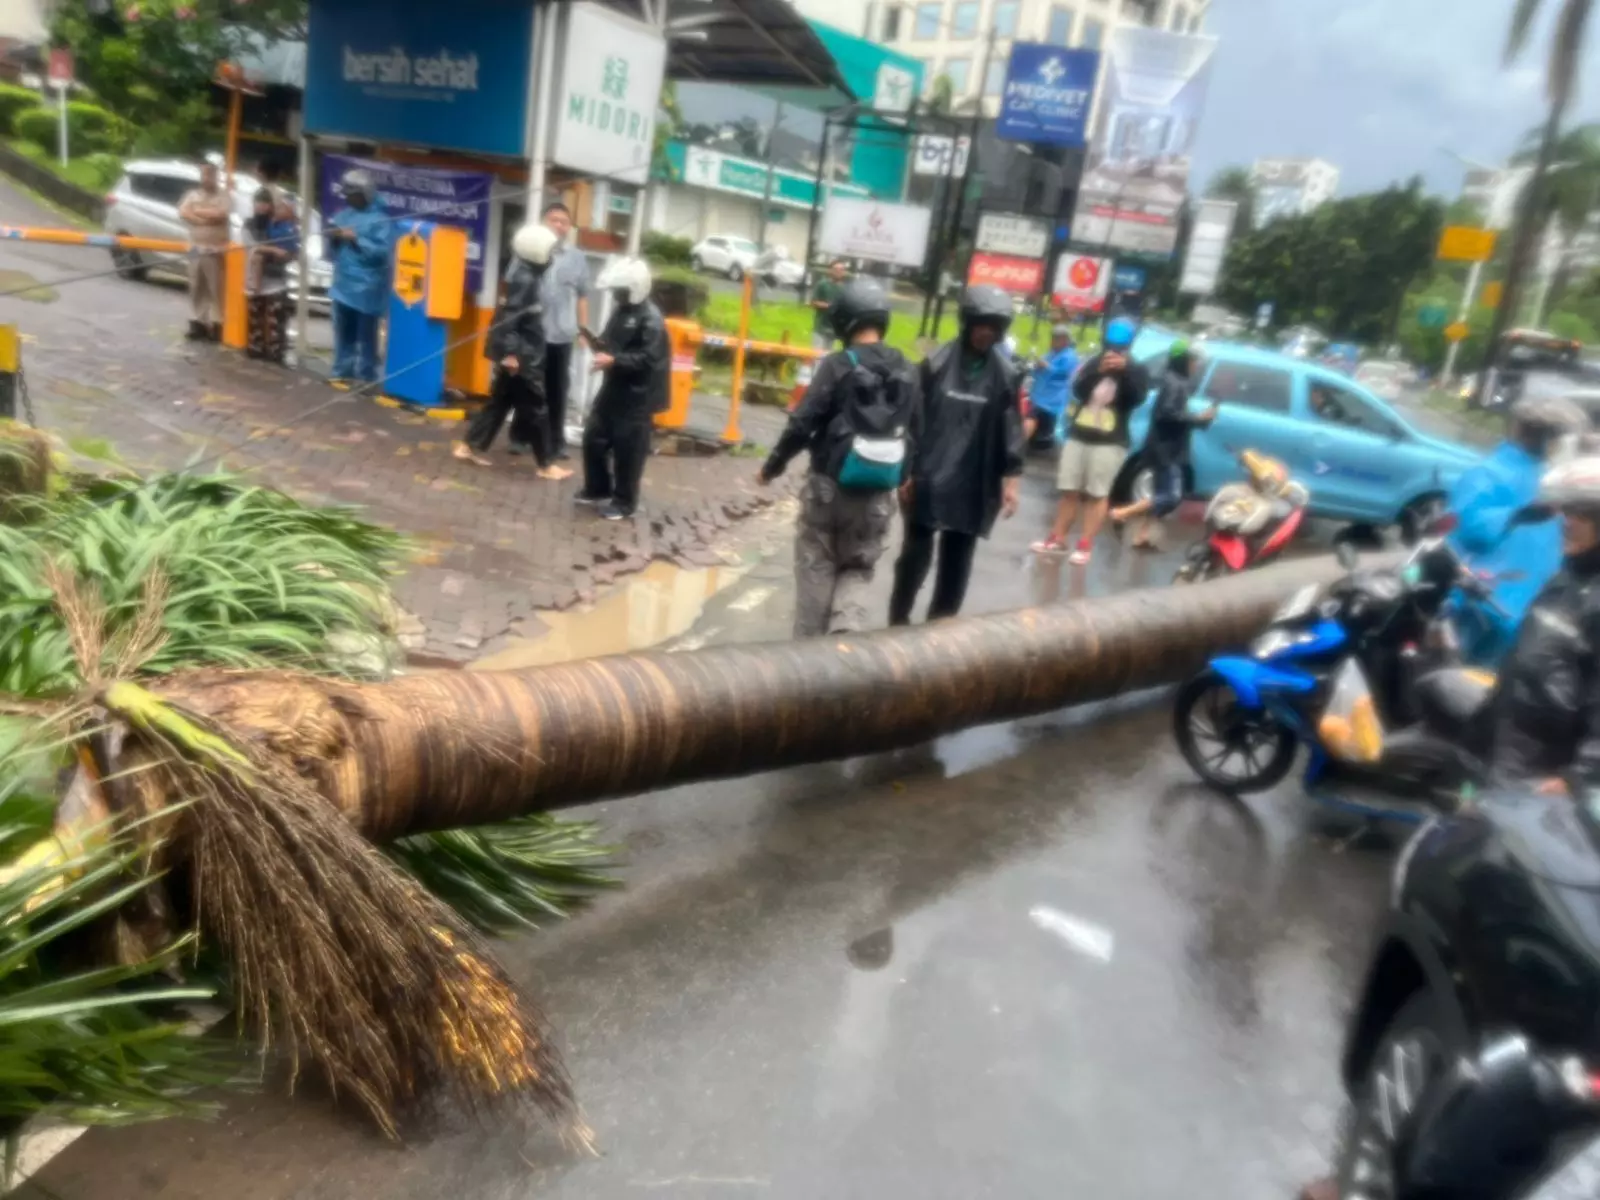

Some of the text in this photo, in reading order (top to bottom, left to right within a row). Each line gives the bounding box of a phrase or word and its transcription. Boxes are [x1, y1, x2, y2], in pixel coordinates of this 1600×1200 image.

[342, 45, 479, 90] bersih sehat
[566, 92, 649, 142] MIDORI
